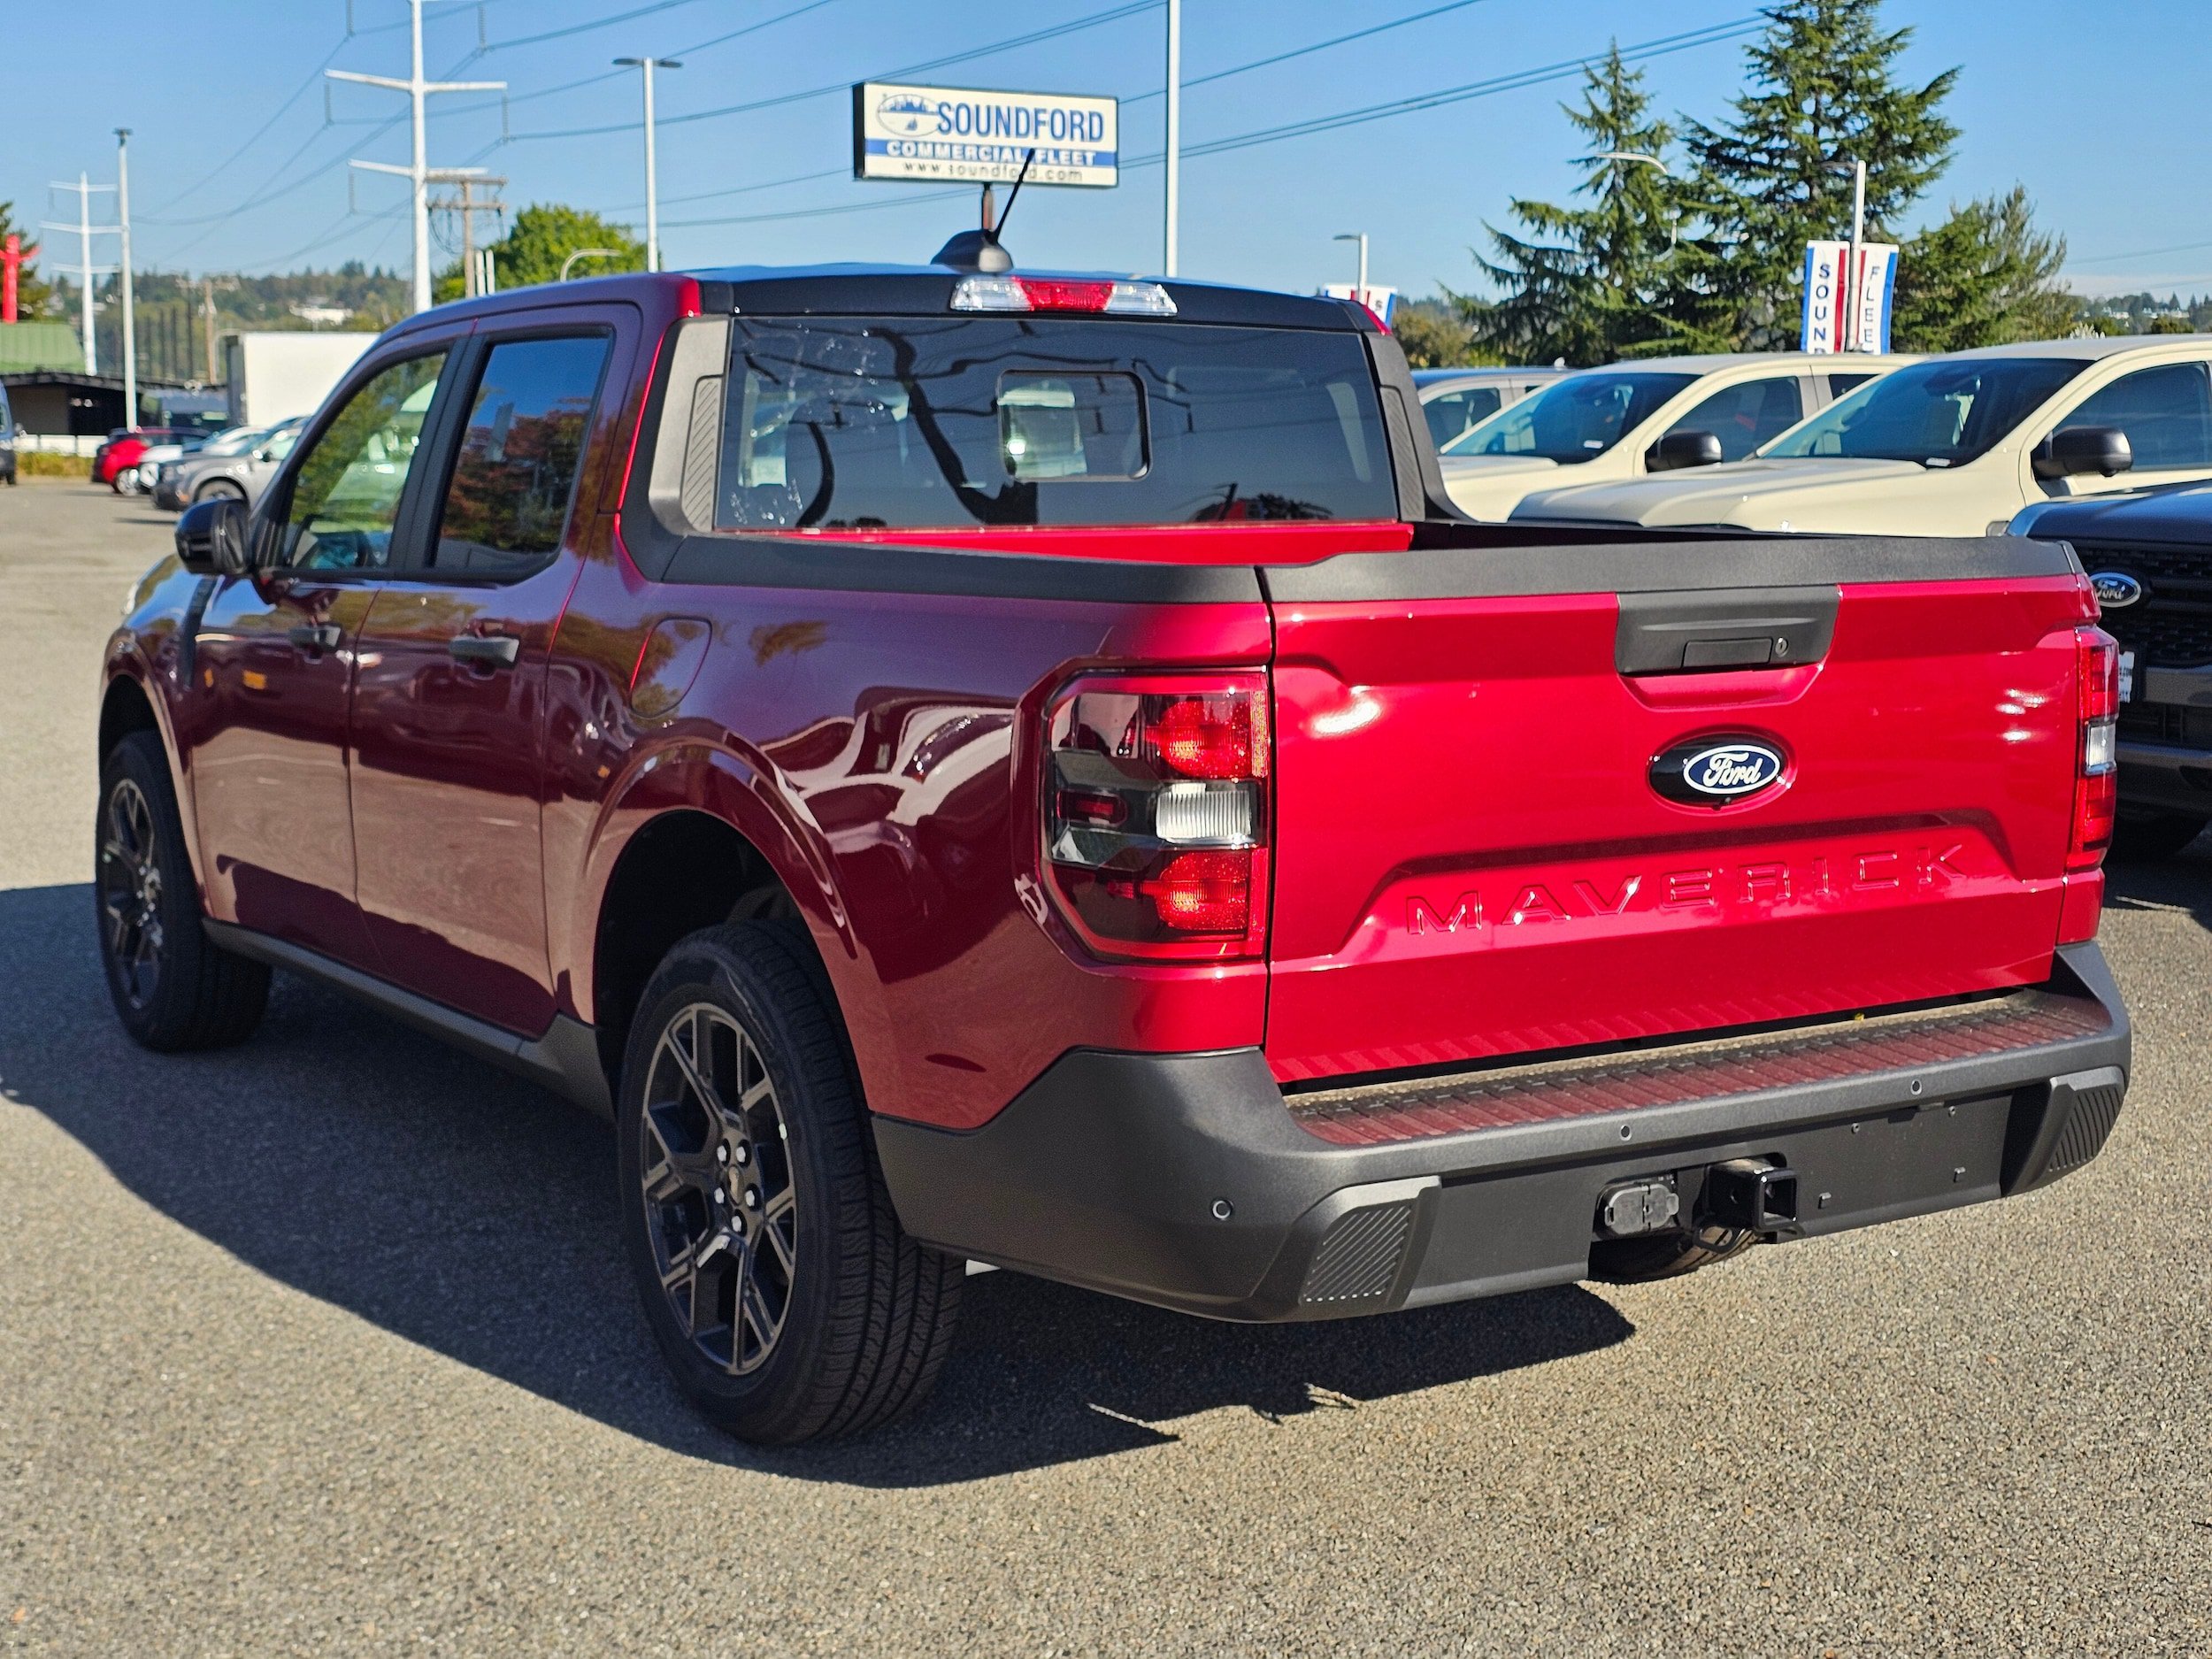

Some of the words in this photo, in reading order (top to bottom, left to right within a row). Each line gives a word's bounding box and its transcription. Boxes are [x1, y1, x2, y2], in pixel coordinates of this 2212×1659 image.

[886, 140, 1027, 164] COMMERCIAL
[1034, 148, 1096, 166] FLEET
[902, 162, 1084, 181] www.soundfod.com
[1864, 265, 1880, 354] FLEE
[1702, 752, 1763, 787] Ford
[1406, 844, 1964, 936] MAVERICK
